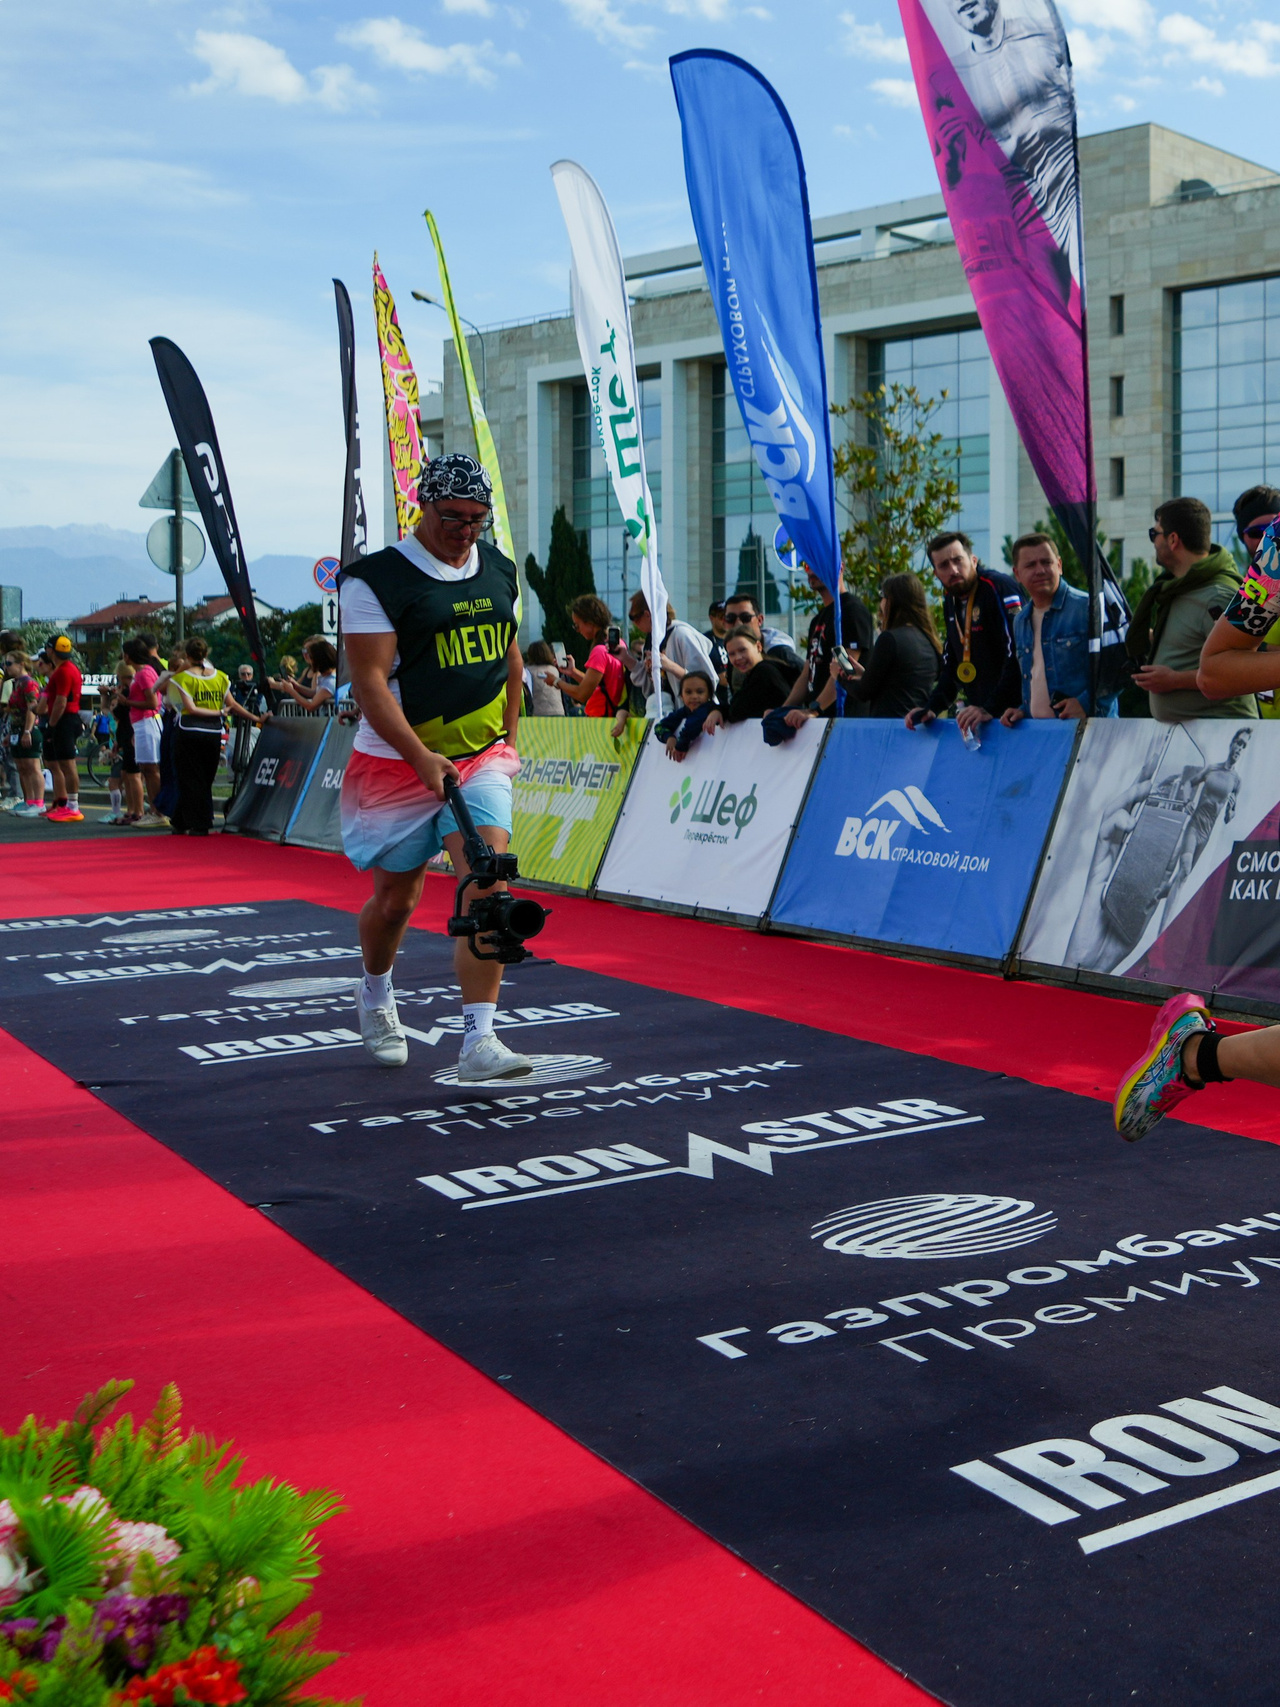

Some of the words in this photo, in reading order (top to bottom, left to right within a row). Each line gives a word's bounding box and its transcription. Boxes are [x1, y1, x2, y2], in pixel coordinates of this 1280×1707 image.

[452, 600, 470, 613] IRON
[474, 597, 493, 609] STAR
[690, 779, 758, 840] Шеф
[834, 816, 901, 861] ВСК
[890, 846, 962, 870] СТРАХОВОЙ
[958, 855, 991, 873] ДОМ
[1229, 878, 1273, 900] КАК
[125, 906, 259, 921] STAR
[43, 961, 197, 983] IRON
[178, 1027, 364, 1062] IRON
[309, 1059, 804, 1134] Газпромбанк
[425, 1080, 772, 1136] Премиум
[415, 1142, 672, 1201] IRON
[740, 1097, 970, 1144] STAR
